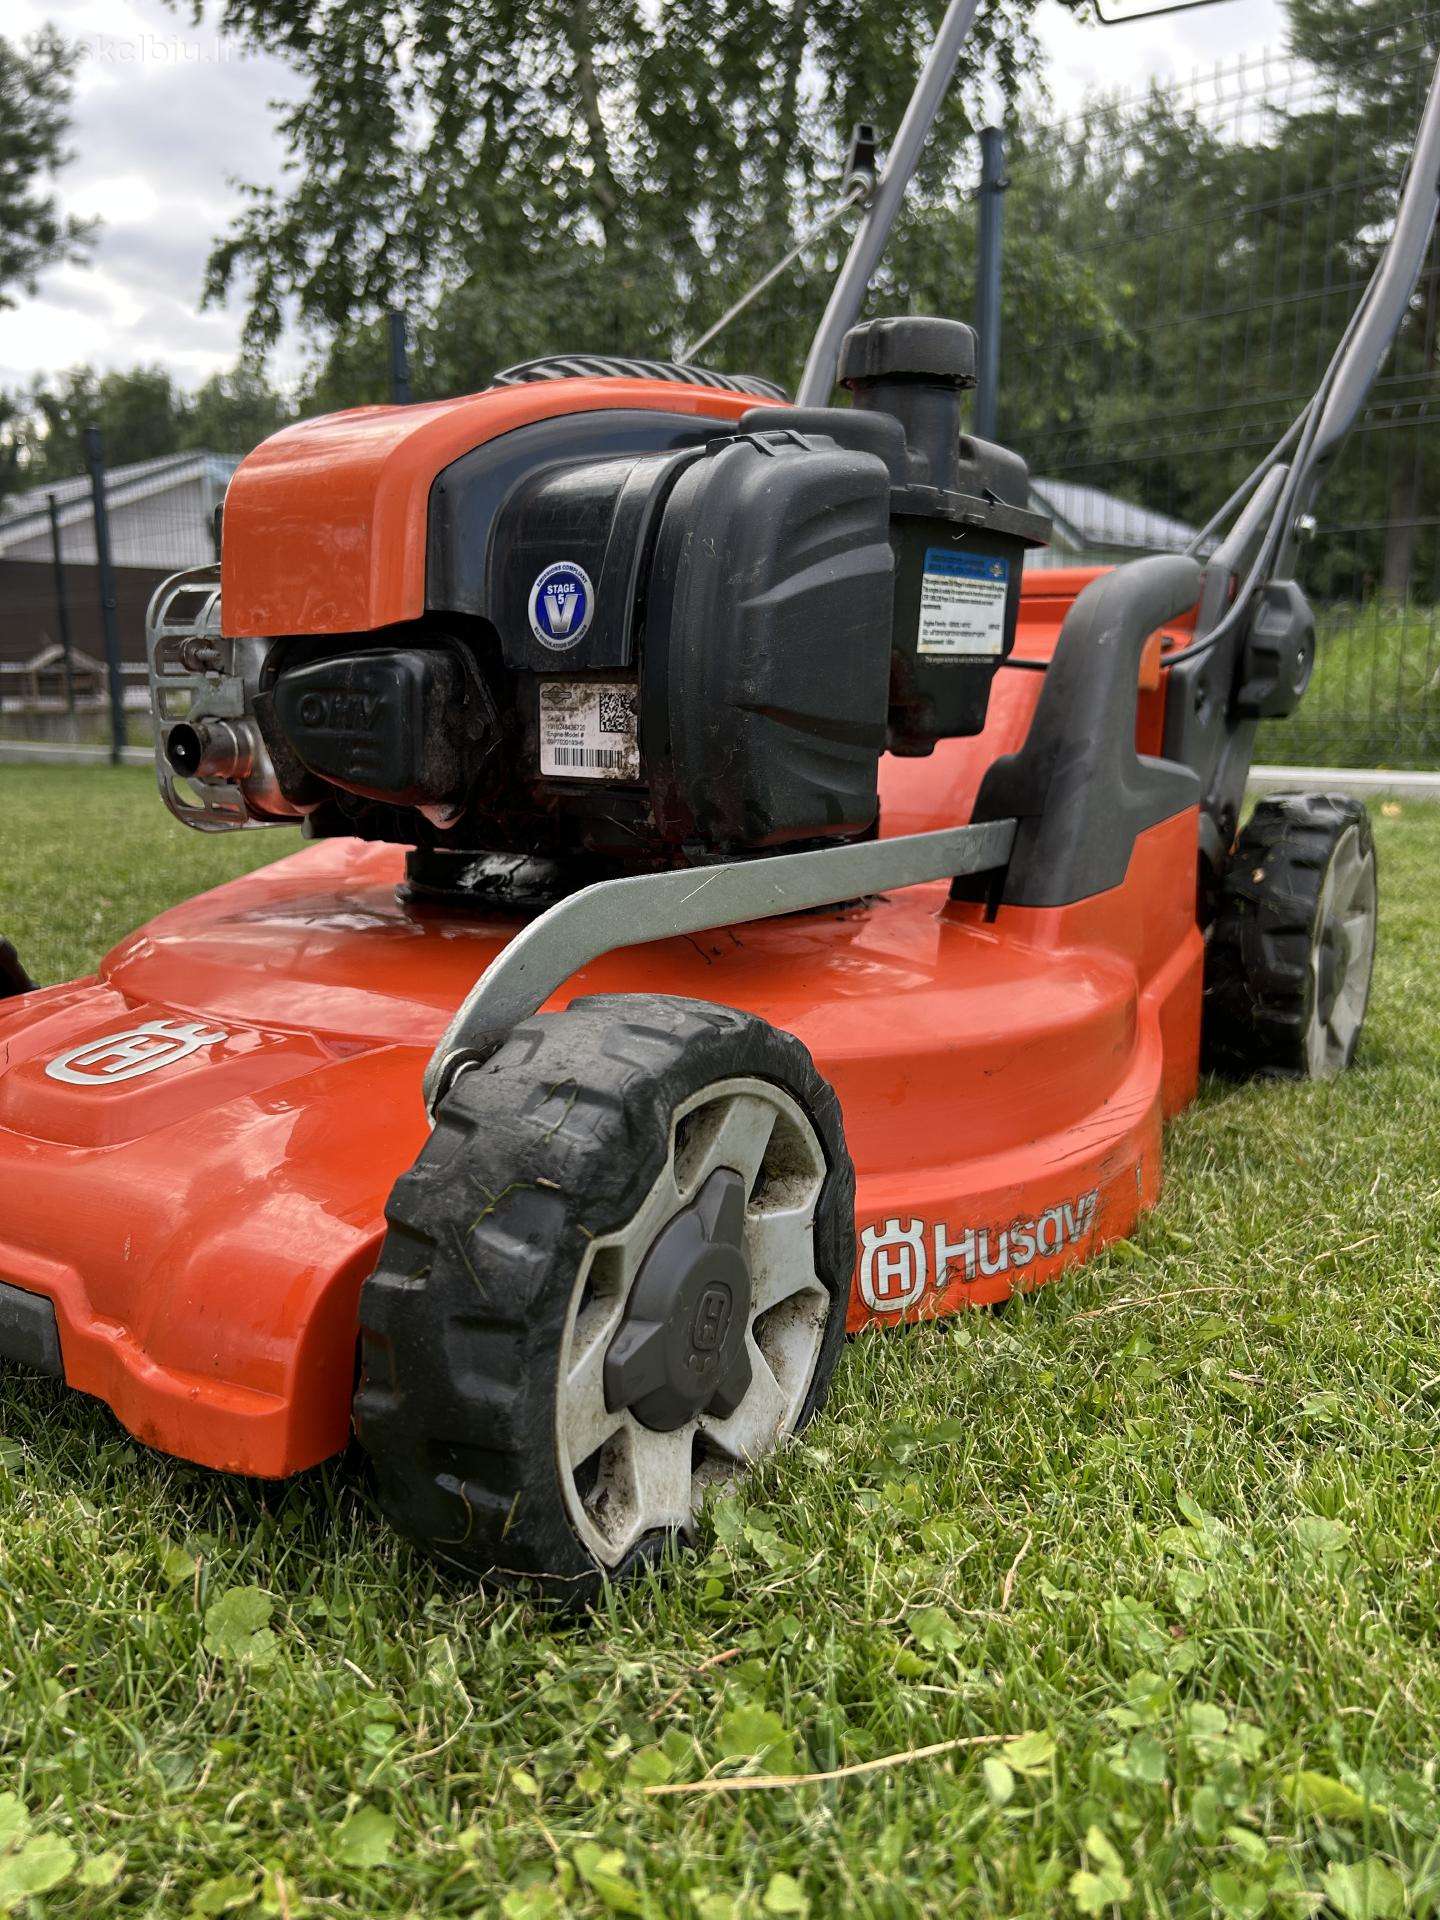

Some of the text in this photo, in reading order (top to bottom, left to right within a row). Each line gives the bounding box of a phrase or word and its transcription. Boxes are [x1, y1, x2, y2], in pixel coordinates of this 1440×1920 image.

[562, 564, 588, 584] COMPLIANT
[547, 583, 576, 594] STAGE
[558, 594, 565, 605] 5
[543, 594, 579, 634] V
